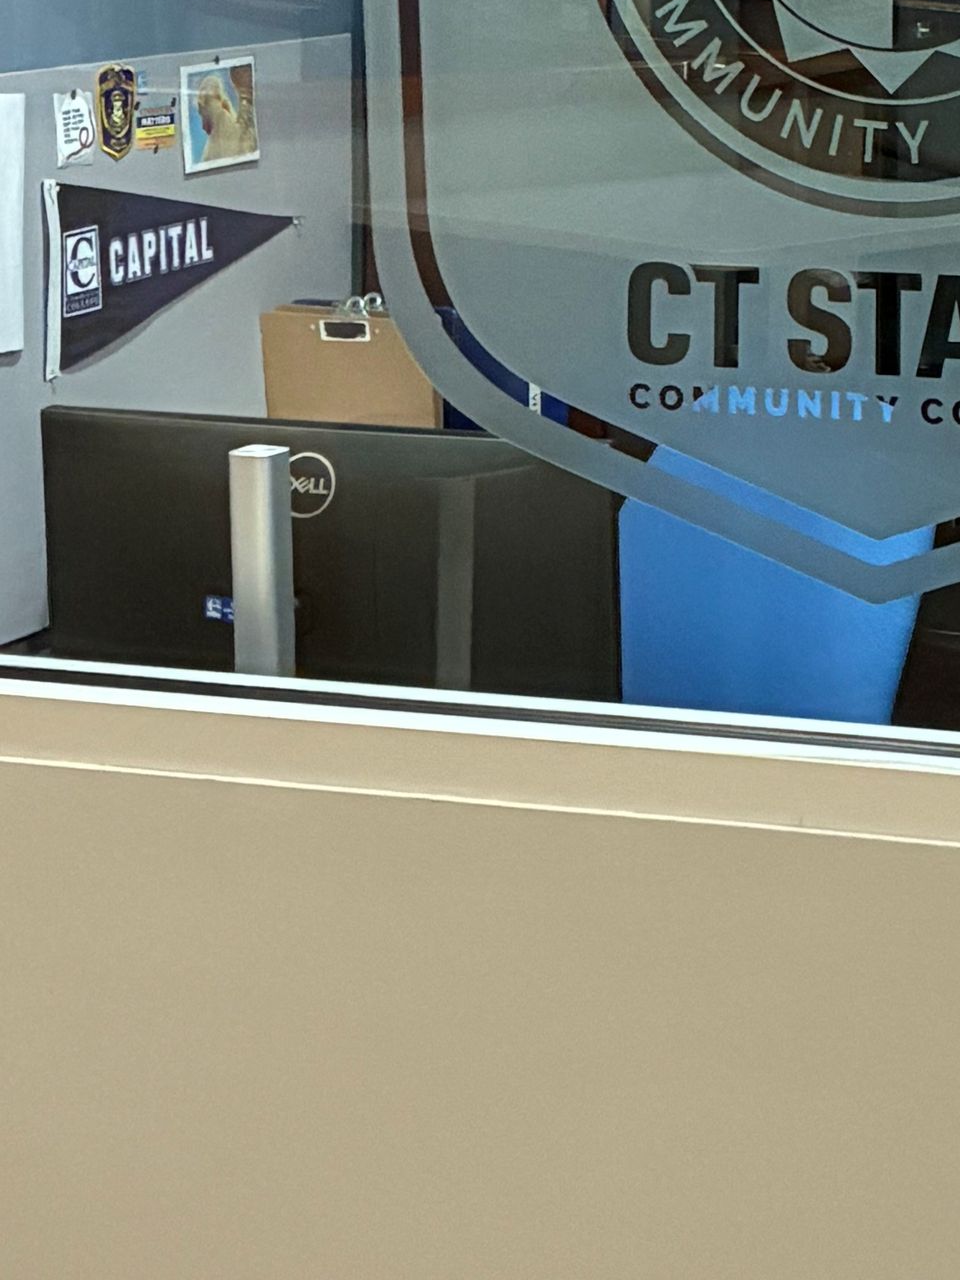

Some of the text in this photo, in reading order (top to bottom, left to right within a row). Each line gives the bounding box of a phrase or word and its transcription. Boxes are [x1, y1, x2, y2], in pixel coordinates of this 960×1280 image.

[109, 216, 215, 287] CAPITAL
[627, 261, 760, 368] CT
[629, 382, 899, 424] COMMUNITY
